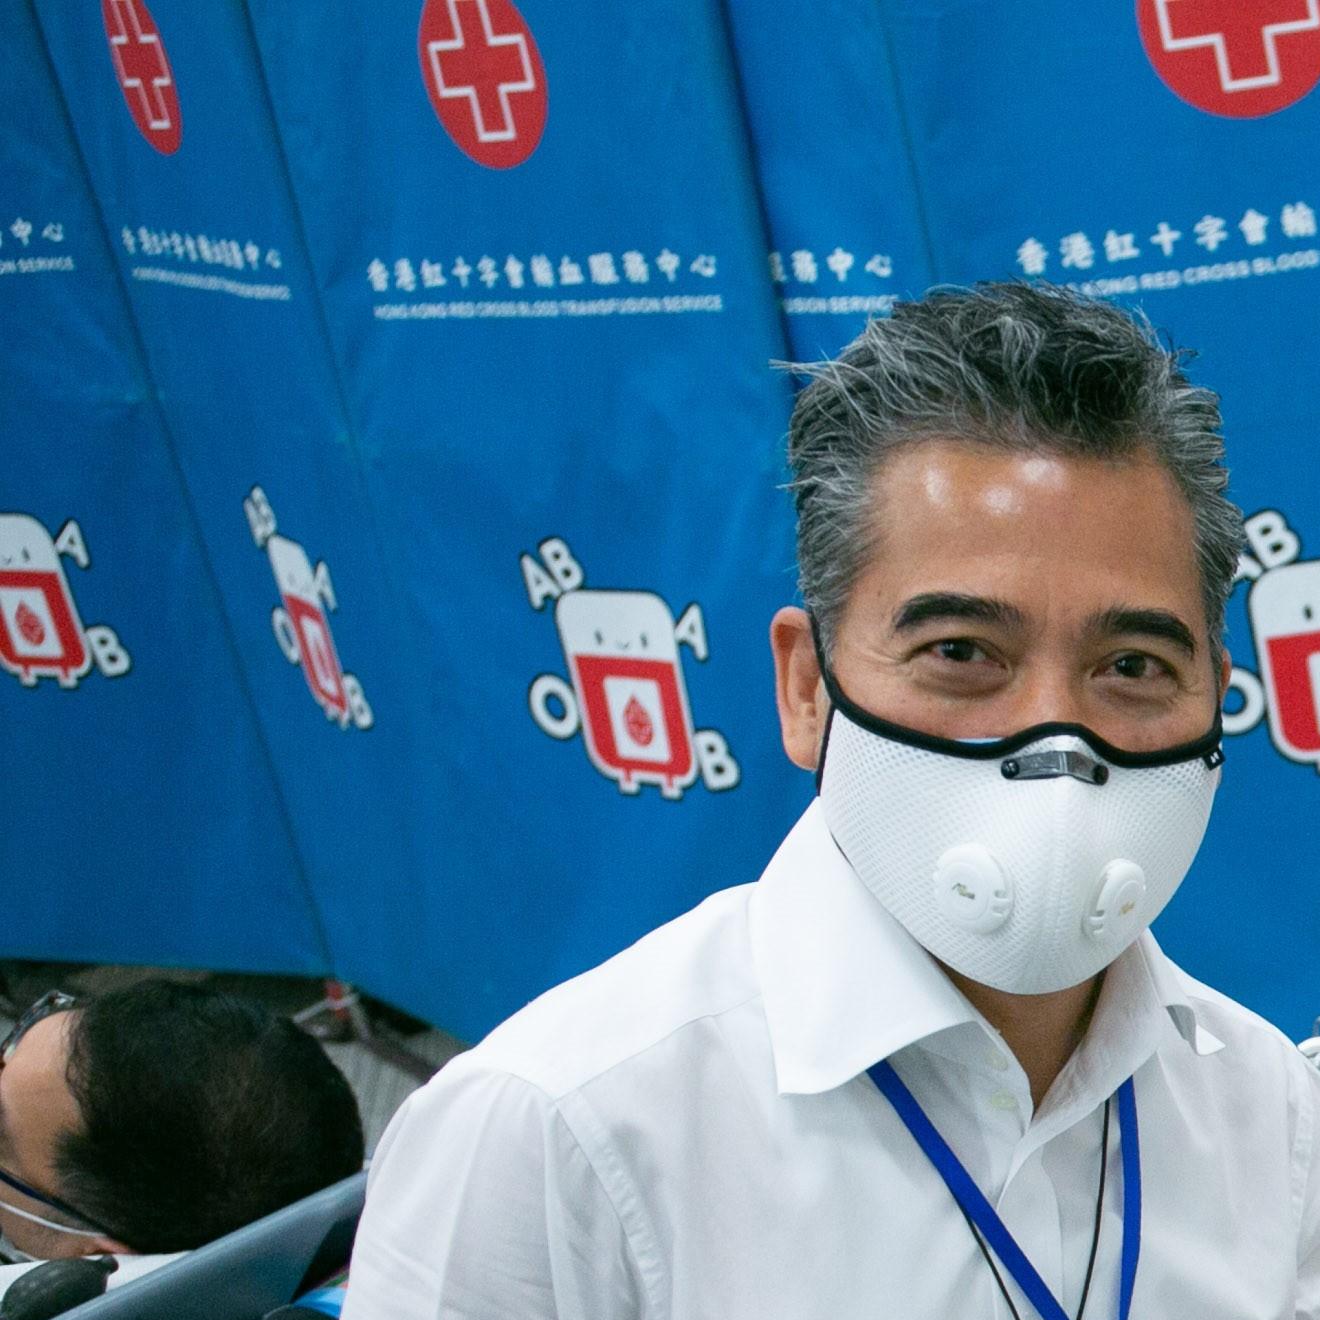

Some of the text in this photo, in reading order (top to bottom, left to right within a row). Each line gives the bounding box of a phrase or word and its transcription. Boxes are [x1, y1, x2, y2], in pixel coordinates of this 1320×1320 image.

[55, 519, 90, 569] A
[520, 537, 584, 609] AB
[85, 625, 131, 677] B
[675, 603, 708, 661] A
[530, 674, 579, 740] O
[695, 729, 740, 790] B
